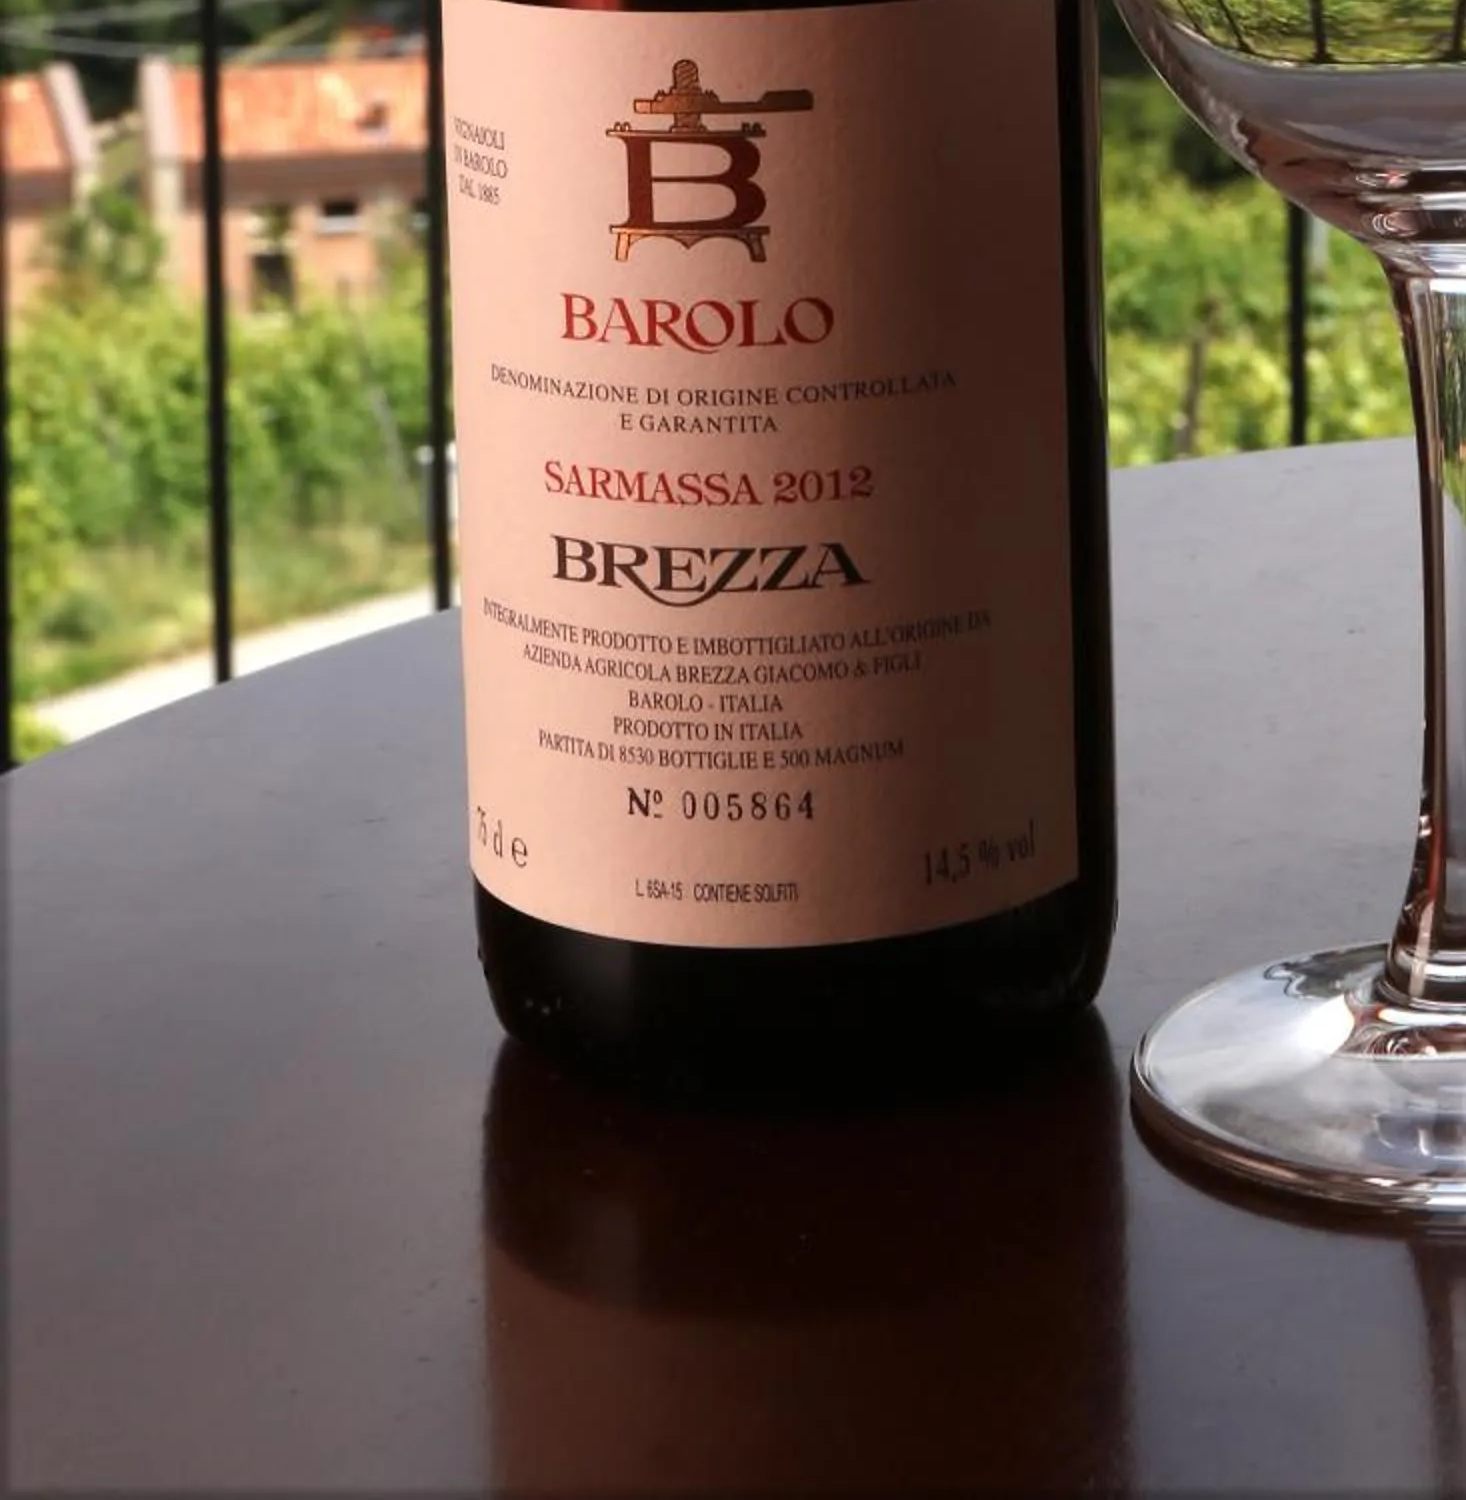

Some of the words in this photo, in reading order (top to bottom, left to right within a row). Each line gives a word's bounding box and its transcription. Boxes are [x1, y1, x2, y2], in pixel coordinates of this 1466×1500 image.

[463, 148, 508, 179] BAROLO
[560, 292, 836, 355] BAROLO
[490, 362, 639, 405] DENOMINAZIONE
[646, 386, 670, 406] DI
[676, 387, 780, 408] ORIGINE
[786, 368, 958, 405] CONTROLLATA
[620, 412, 634, 431] E
[639, 414, 779, 434] GARANTITA
[544, 460, 763, 507] SARMASSA
[773, 465, 875, 504] 2012
[550, 533, 872, 608] BREZZA
[483, 597, 578, 644] INTEGRALMENTE
[582, 627, 673, 655] PRODOTTO
[677, 636, 691, 655] E
[693, 632, 846, 657] IMBOTTIGLIATO
[850, 617, 963, 650] ALL'ORIGINE
[522, 643, 583, 673] AZIENDA
[585, 656, 672, 684] AGRICOLA
[676, 664, 750, 686] BREZZA
[754, 661, 850, 685] GIACOMO
[853, 660, 868, 679] &
[873, 650, 923, 676] FIGLI
[628, 689, 704, 714] BAROLO
[719, 694, 784, 714] ITALIA
[538, 729, 596, 760] PARTITA
[598, 743, 616, 763] DI
[619, 745, 656, 767] 8530
[658, 749, 758, 771] BOTTIGLIE
[763, 750, 777, 770] E
[781, 749, 811, 769] 500
[814, 739, 905, 767] MAGNUM
[613, 716, 710, 742] PRODOTTO
[714, 722, 735, 742] IN
[740, 721, 805, 742] ITALIA
[682, 789, 815, 822] 005864
[922, 842, 973, 886] 14,5
[978, 833, 1001, 870] %
[1005, 816, 1037, 864] vol
